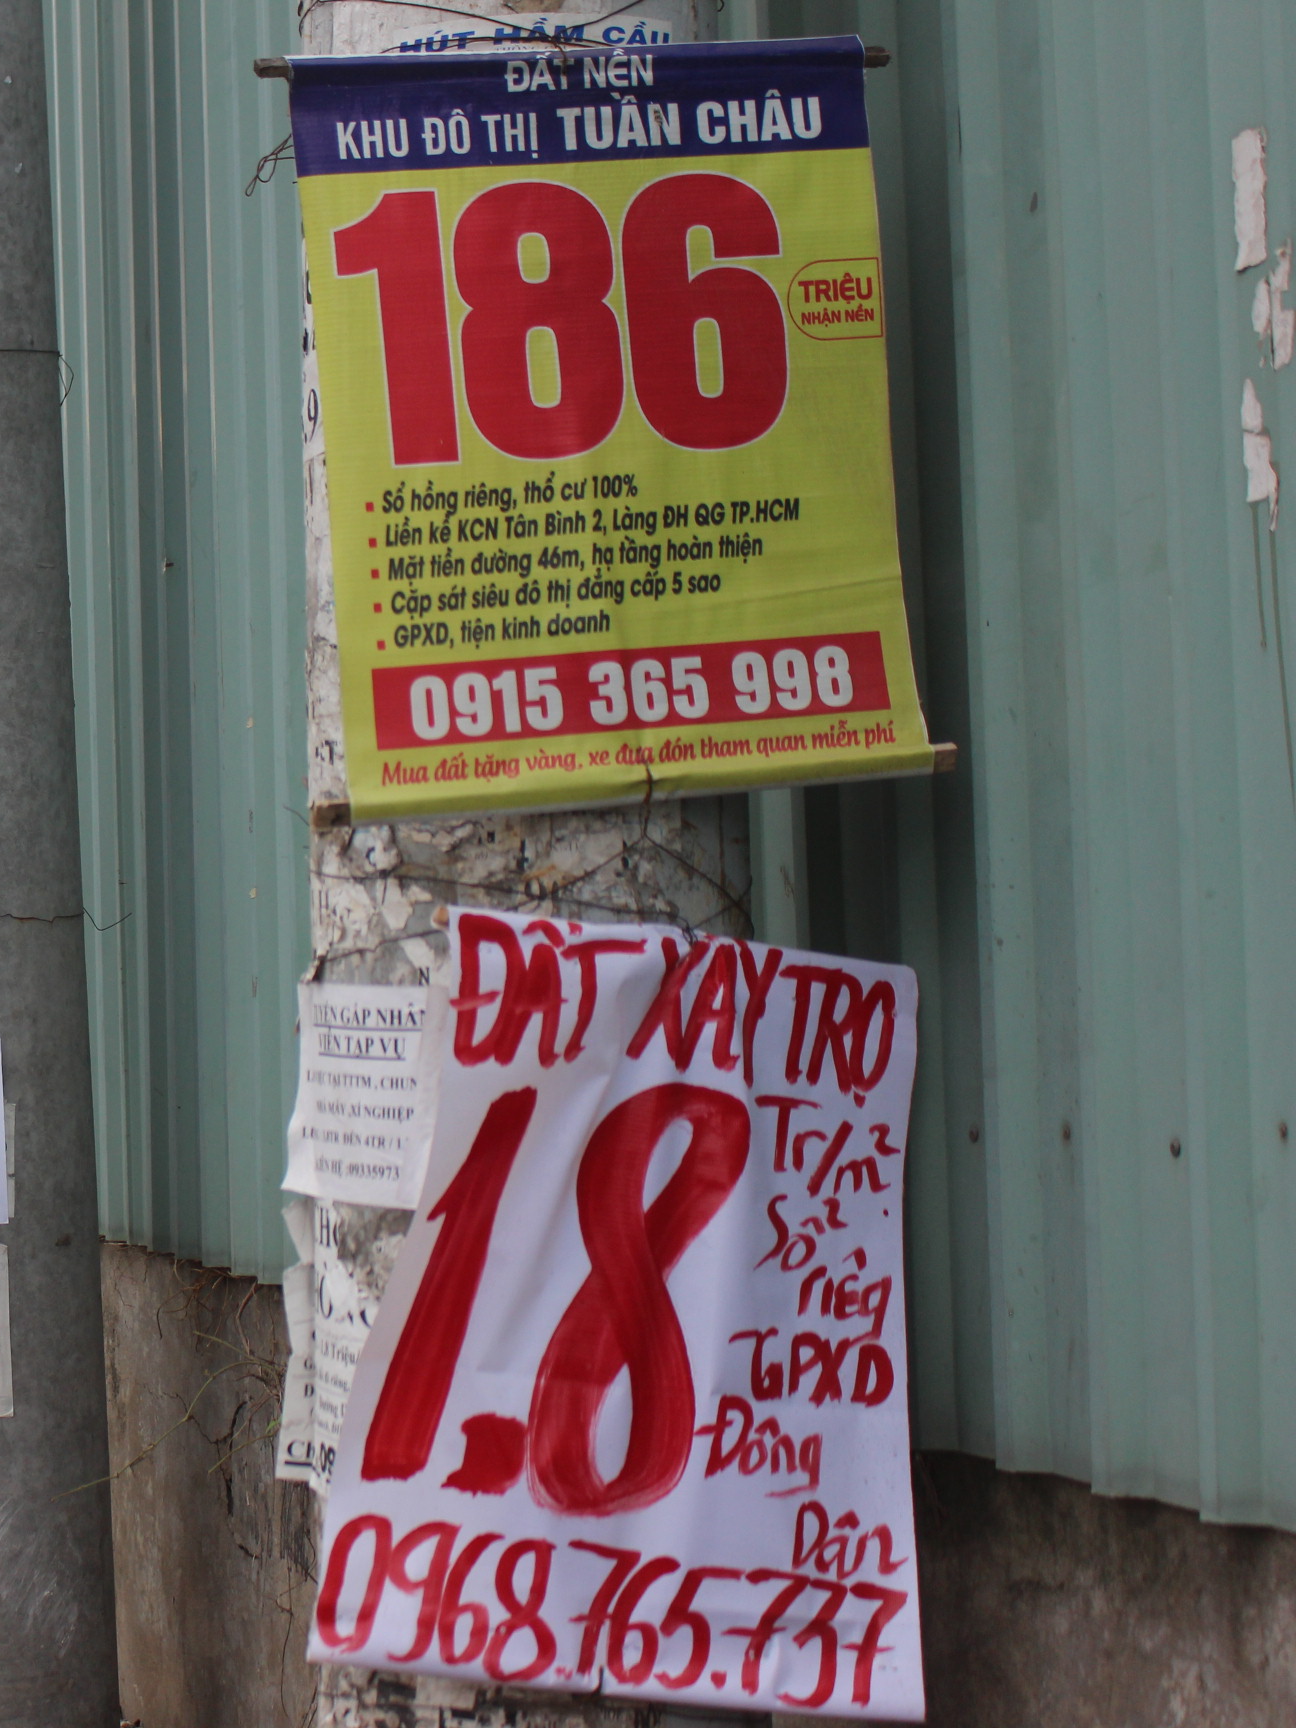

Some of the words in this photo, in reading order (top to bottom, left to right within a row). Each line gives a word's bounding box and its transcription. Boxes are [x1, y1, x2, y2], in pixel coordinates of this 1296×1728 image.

[505, 51, 574, 93] ĐẤT
[584, 48, 654, 89] NỀN
[336, 118, 409, 160] KHU
[422, 109, 471, 156] ĐÔ
[481, 112, 539, 159] THỊ
[556, 92, 681, 151] TUẦN
[696, 89, 822, 145] CHÂU
[798, 272, 872, 304] TRIỆU
[332, 172, 788, 468] 186
[801, 308, 841, 327] NHẬN
[382, 480, 405, 513] Sổ
[411, 480, 458, 515] hồng
[464, 482, 517, 512] riêng,
[524, 471, 555, 503] thổ
[561, 477, 586, 501] cư
[593, 474, 638, 498] 100%
[385, 516, 422, 547] Liền
[458, 517, 498, 541] KCN
[505, 514, 538, 538] Tân
[545, 510, 585, 536] Bình
[592, 509, 607, 536] 2,
[612, 506, 657, 536] Làng
[663, 505, 689, 528] ĐH
[695, 502, 725, 526] QG
[731, 498, 800, 524] TP.HCM
[388, 556, 424, 586] Mặt
[430, 547, 464, 578] tiền
[471, 549, 532, 579] đường
[538, 547, 585, 571] 46m,
[593, 543, 613, 571] hạ
[619, 536, 661, 570] tầng
[667, 535, 713, 562] hoàn
[719, 532, 763, 563] thiện
[391, 588, 431, 620] Cặp
[438, 585, 467, 612] sát
[472, 583, 509, 609] siêu
[516, 579, 541, 605] đô
[547, 579, 571, 608] thị
[577, 567, 624, 605] đẳng
[630, 569, 666, 601] cấp
[672, 571, 683, 595] 5
[688, 574, 721, 594] sao
[394, 623, 454, 649] GPXD,
[461, 618, 495, 650] tiện
[502, 615, 540, 641] kinh
[547, 610, 610, 636] doanh
[410, 666, 564, 741] 0915
[589, 656, 709, 725] 365
[731, 645, 853, 715] 998
[382, 761, 430, 786] Mua
[434, 752, 468, 782] đất
[474, 754, 520, 782] tặng
[525, 748, 583, 772] vàng,
[589, 749, 612, 766] xe
[615, 743, 655, 765] đưa
[659, 737, 696, 764] đón
[700, 735, 753, 760] tham
[757, 733, 807, 757] quan
[811, 720, 860, 750] miễn
[864, 720, 896, 750] phí
[450, 913, 647, 1069] ĐẤT
[780, 964, 897, 1108] TRỌ
[346, 1036, 374, 1058] TẠP
[380, 1038, 406, 1060] VỤ
[364, 1105, 414, 1124] NGHIỆP
[361, 1081, 752, 1516] 1.8
